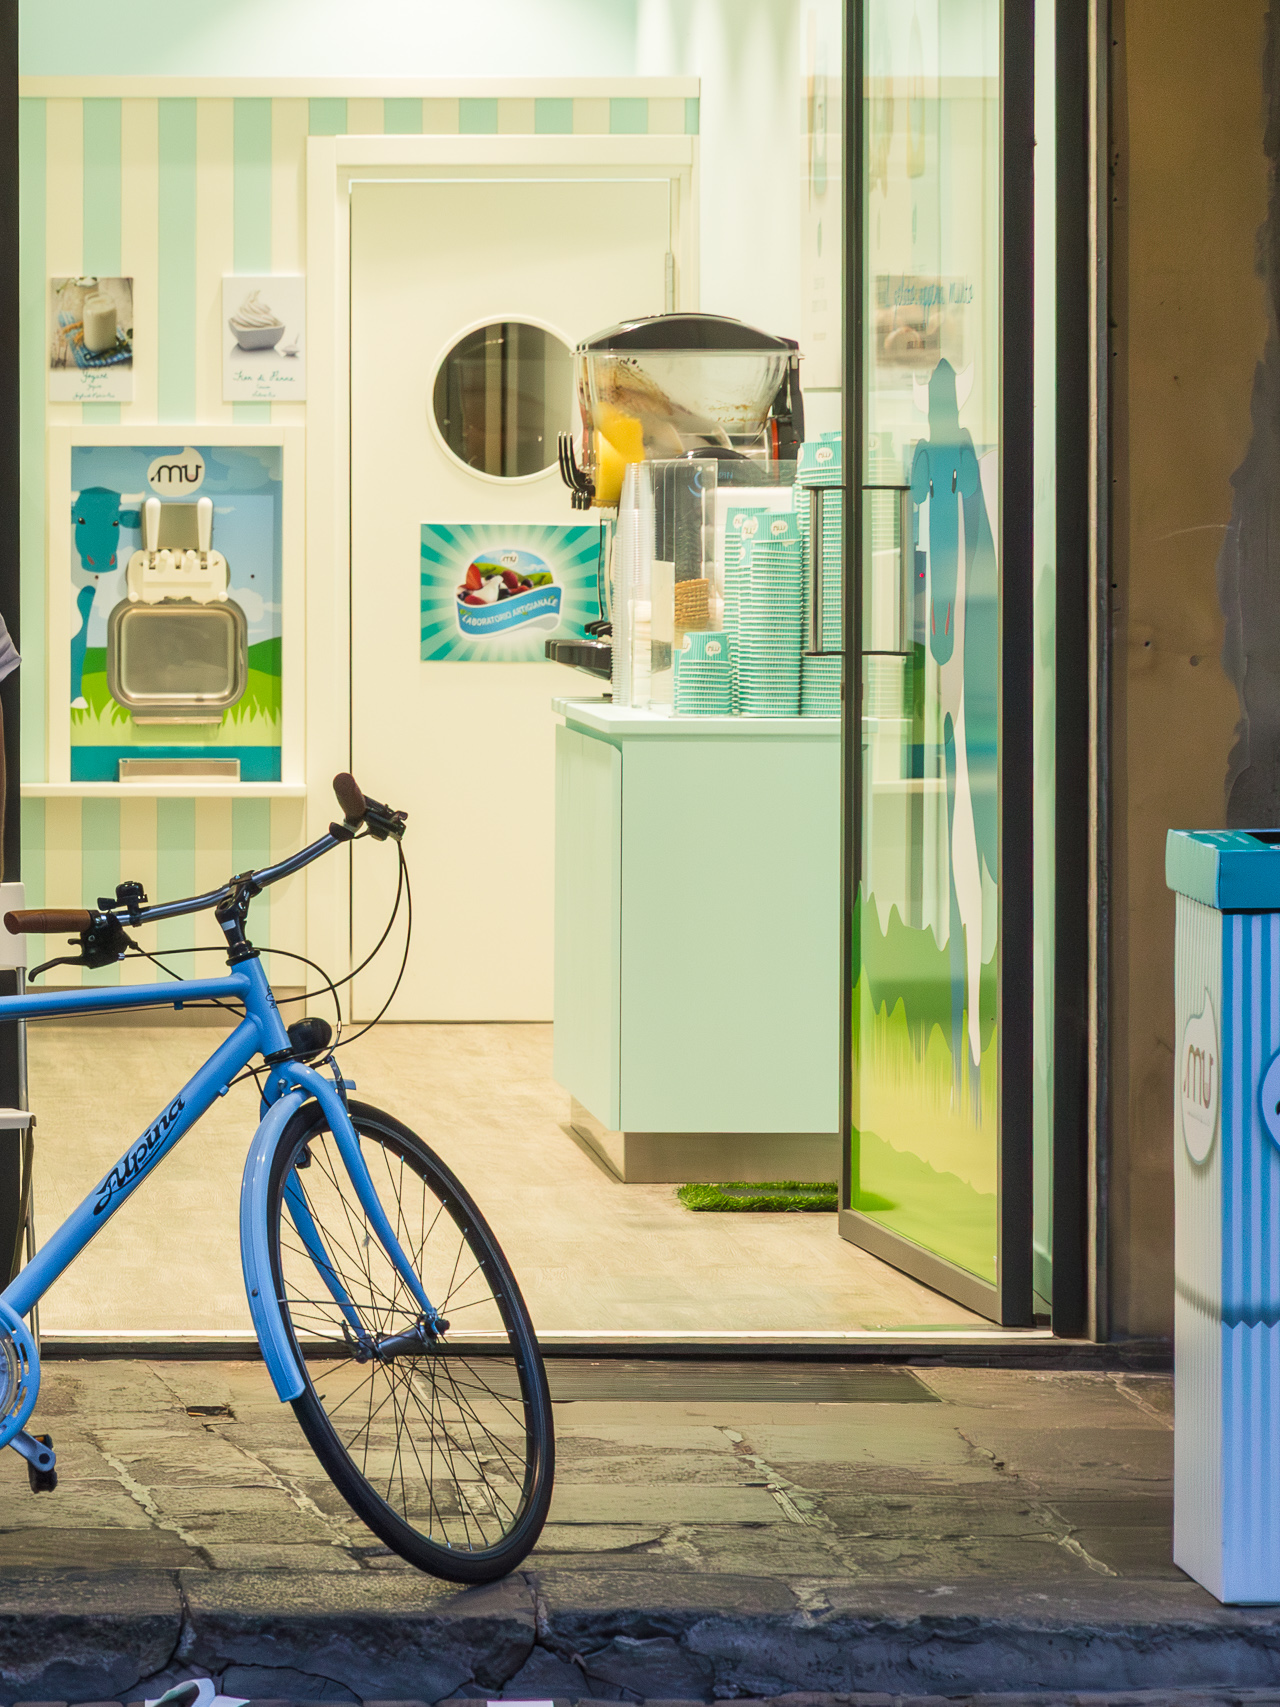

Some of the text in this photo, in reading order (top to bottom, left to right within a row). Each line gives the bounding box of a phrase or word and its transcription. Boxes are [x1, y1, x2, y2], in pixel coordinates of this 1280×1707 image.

[150, 464, 202, 483] mu
[461, 597, 559, 626] LABORATORIO ARTIGIANALE
[1182, 1043, 1214, 1110] mu
[93, 1093, 186, 1217] Alpina
